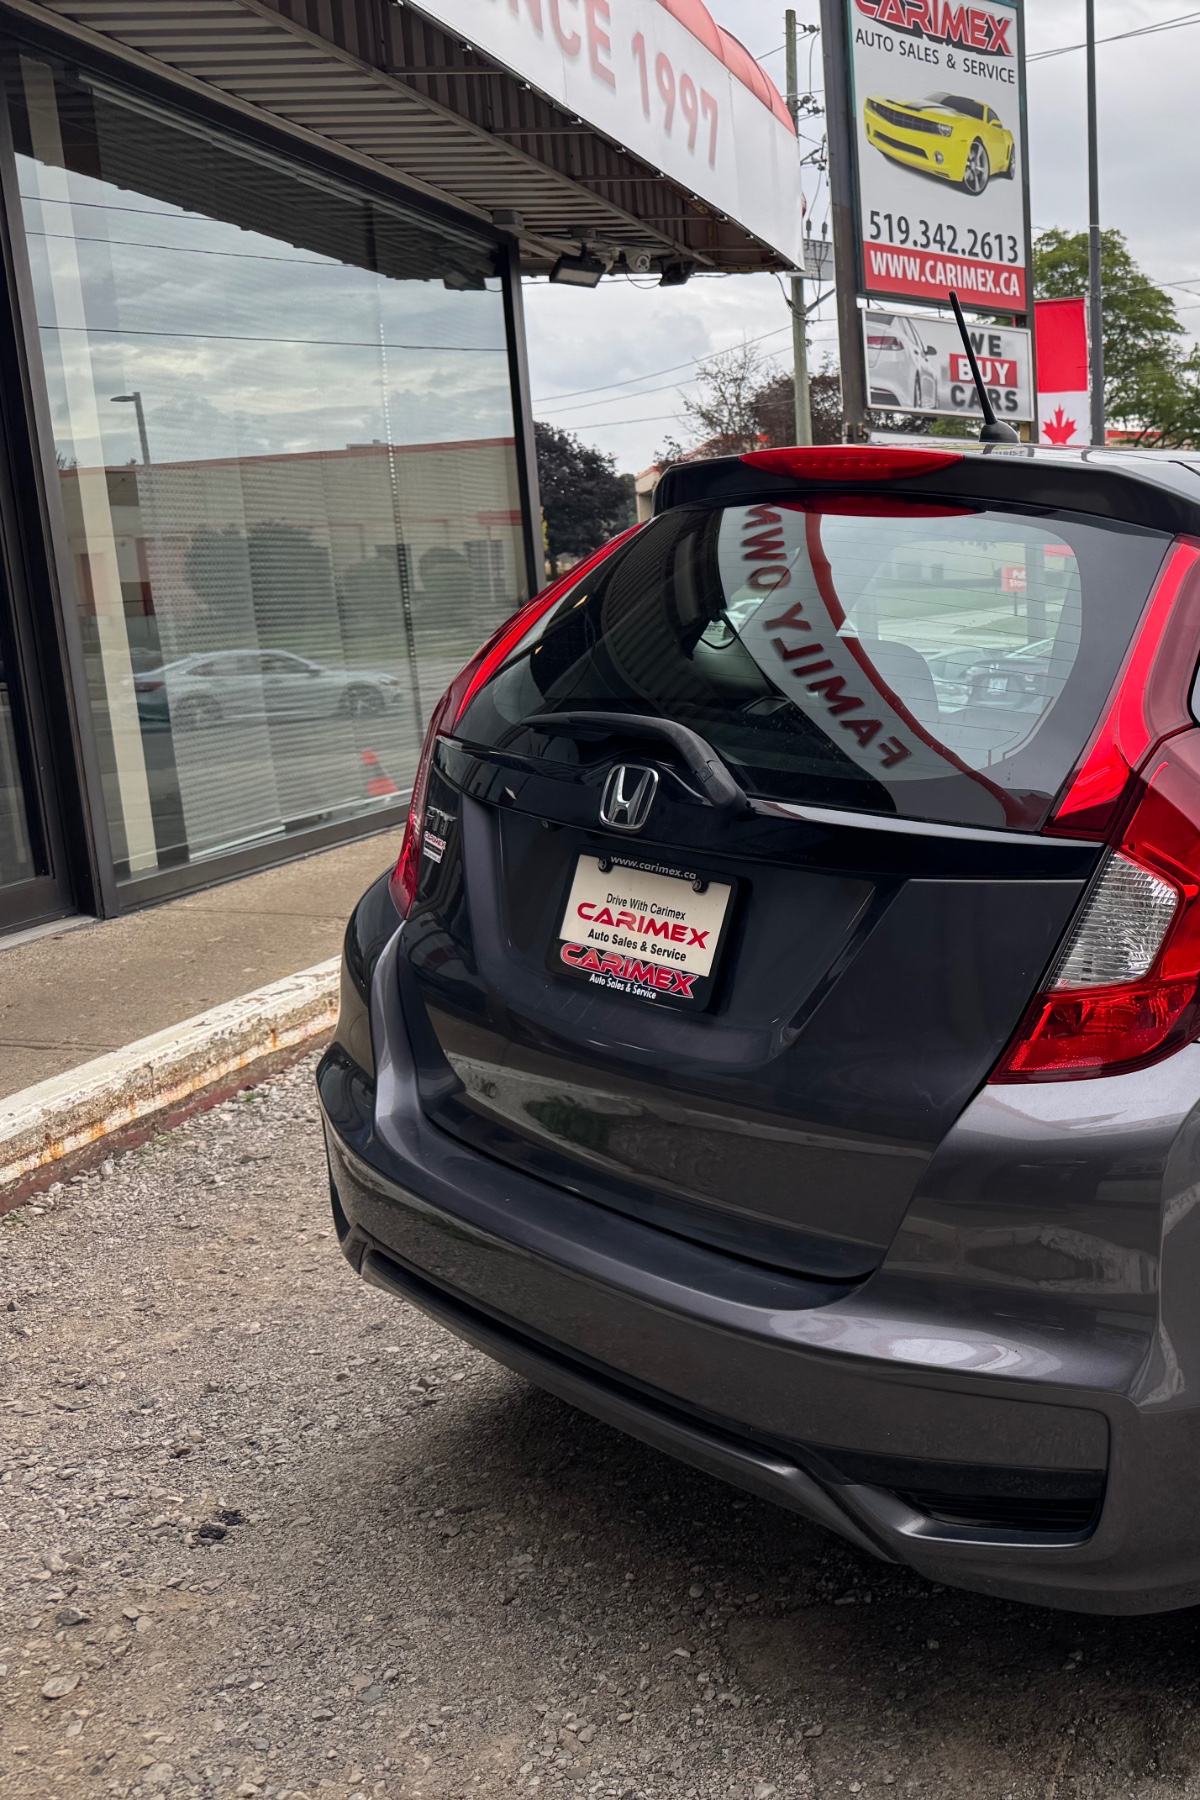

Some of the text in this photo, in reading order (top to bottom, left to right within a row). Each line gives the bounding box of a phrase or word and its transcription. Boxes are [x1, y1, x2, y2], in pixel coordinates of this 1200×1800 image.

[855, 28, 1015, 84] AUTO SALES & SERVICE
[632, 31, 718, 167] 1997
[870, 210, 1018, 263] 519.342.2613
[870, 250, 1020, 297] WWW.CARIMEX.CA
[968, 332, 1002, 357] WE
[958, 358, 1010, 385] BUY
[951, 385, 1018, 412] CARS
[611, 856, 697, 880] www.carimex.ca
[606, 893, 686, 921] Drive With Carimex
[577, 902, 710, 950] CARIMEX
[588, 928, 687, 962] Auto Sales & Service
[560, 942, 699, 998] CARIMEX
[589, 973, 657, 999] Auto Sales & Service
